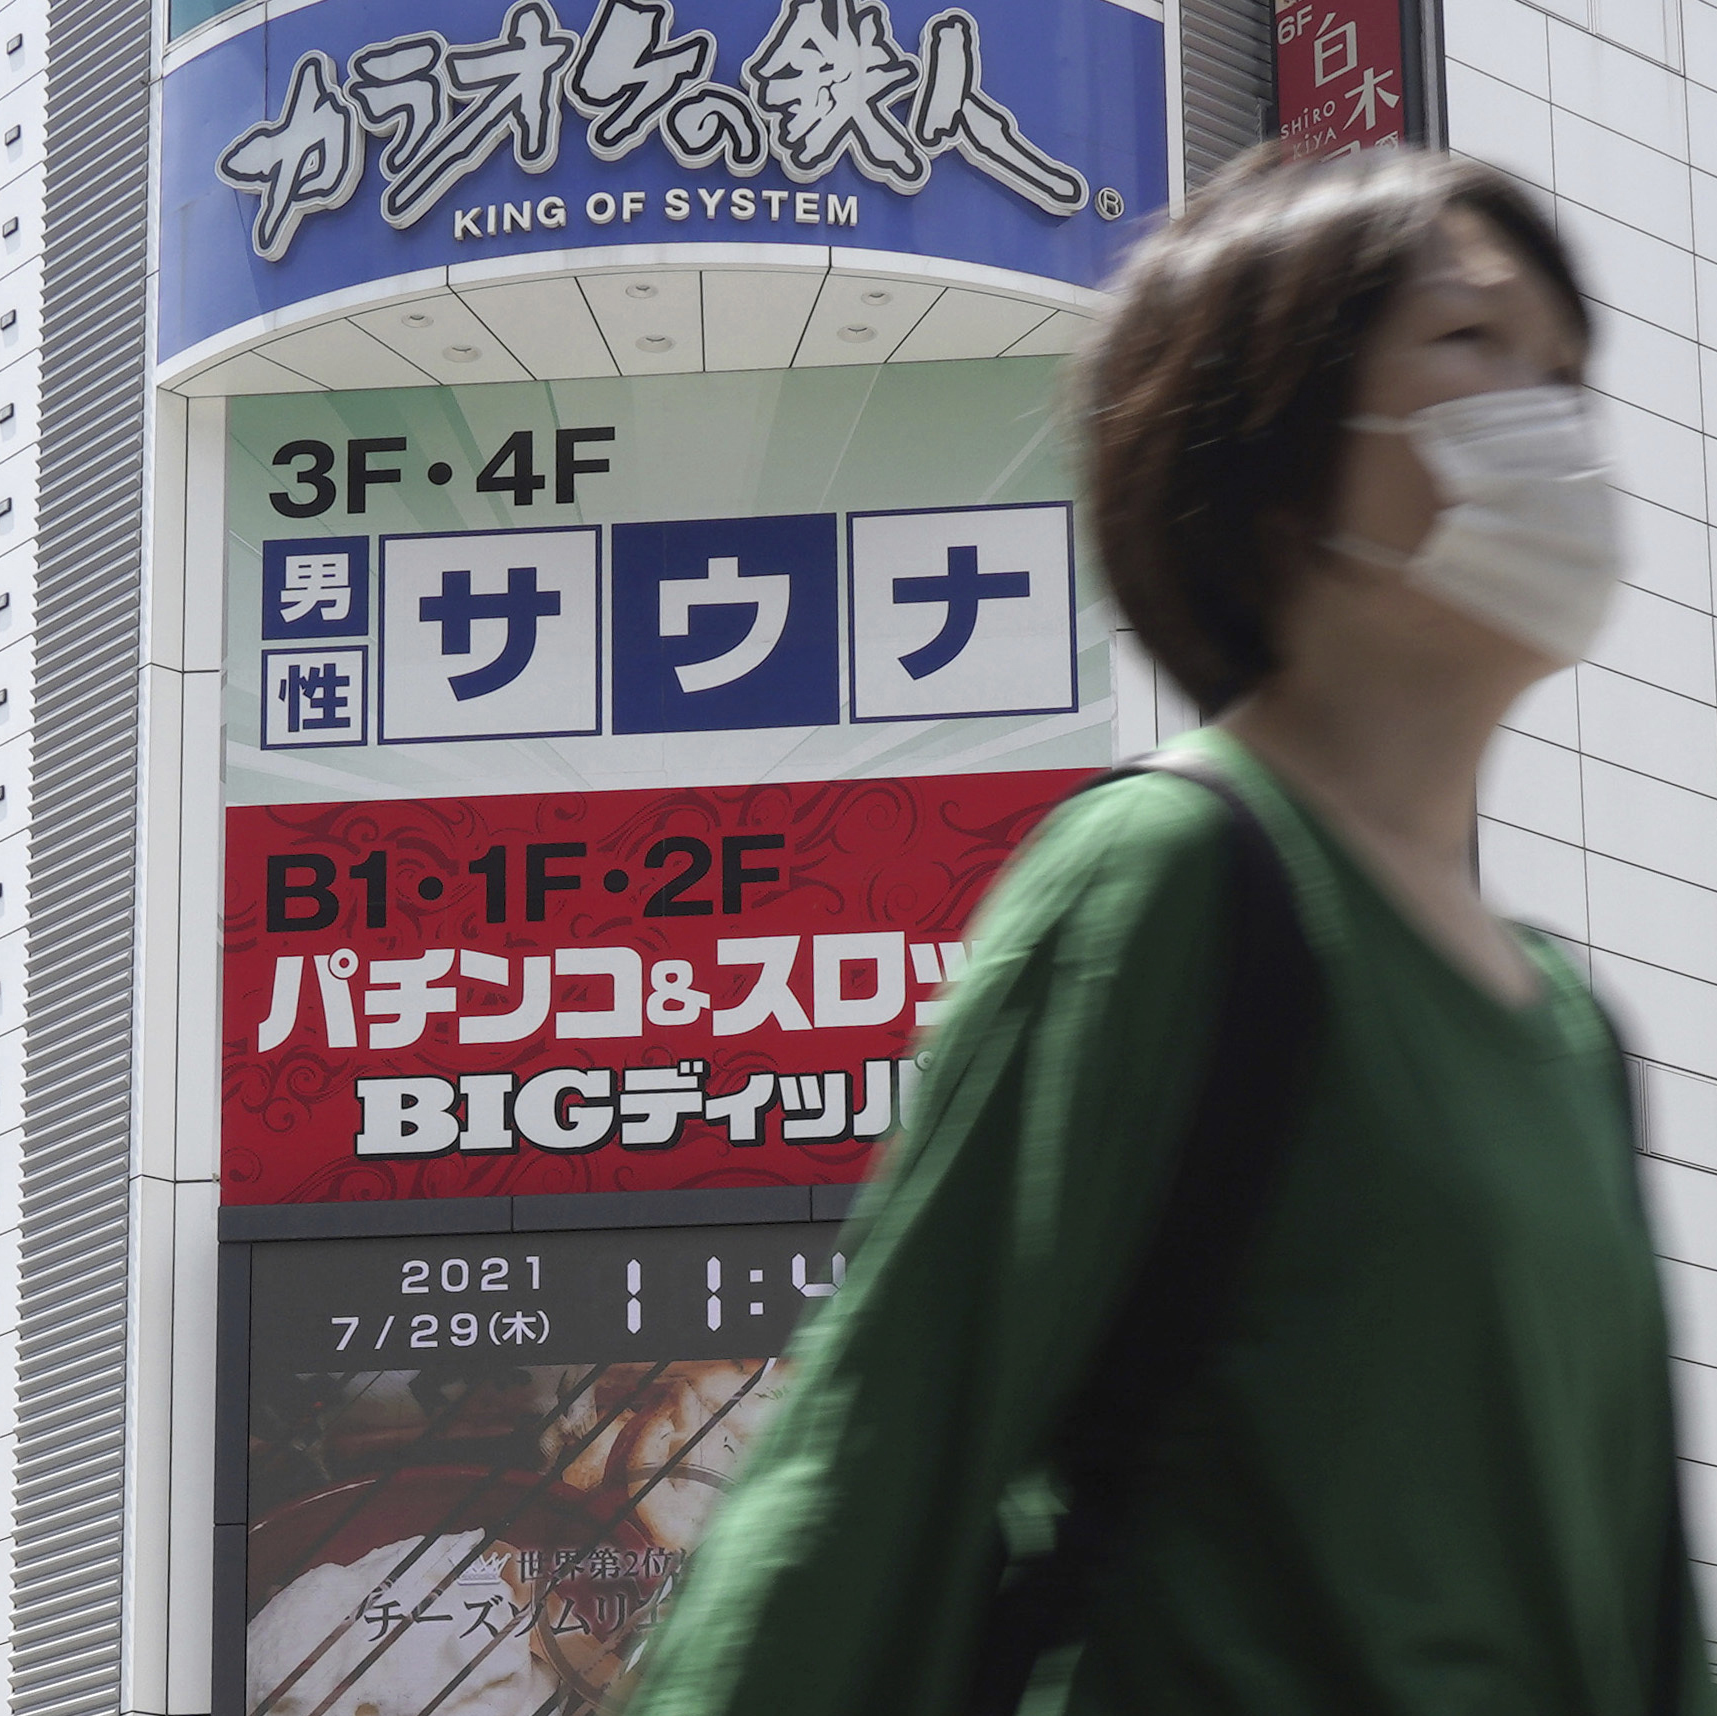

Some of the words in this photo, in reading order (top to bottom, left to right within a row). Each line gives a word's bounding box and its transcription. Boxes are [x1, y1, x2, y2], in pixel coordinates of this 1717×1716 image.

[1277, 5, 1313, 45] 6F
[1314, 13, 1400, 163] 白木
[452, 194, 568, 239] KING
[585, 189, 647, 226] OF
[664, 188, 860, 229] SYSTEM
[257, 931, 981, 1054] パチンコ&スロッ
[400, 1255, 544, 1294] 2021
